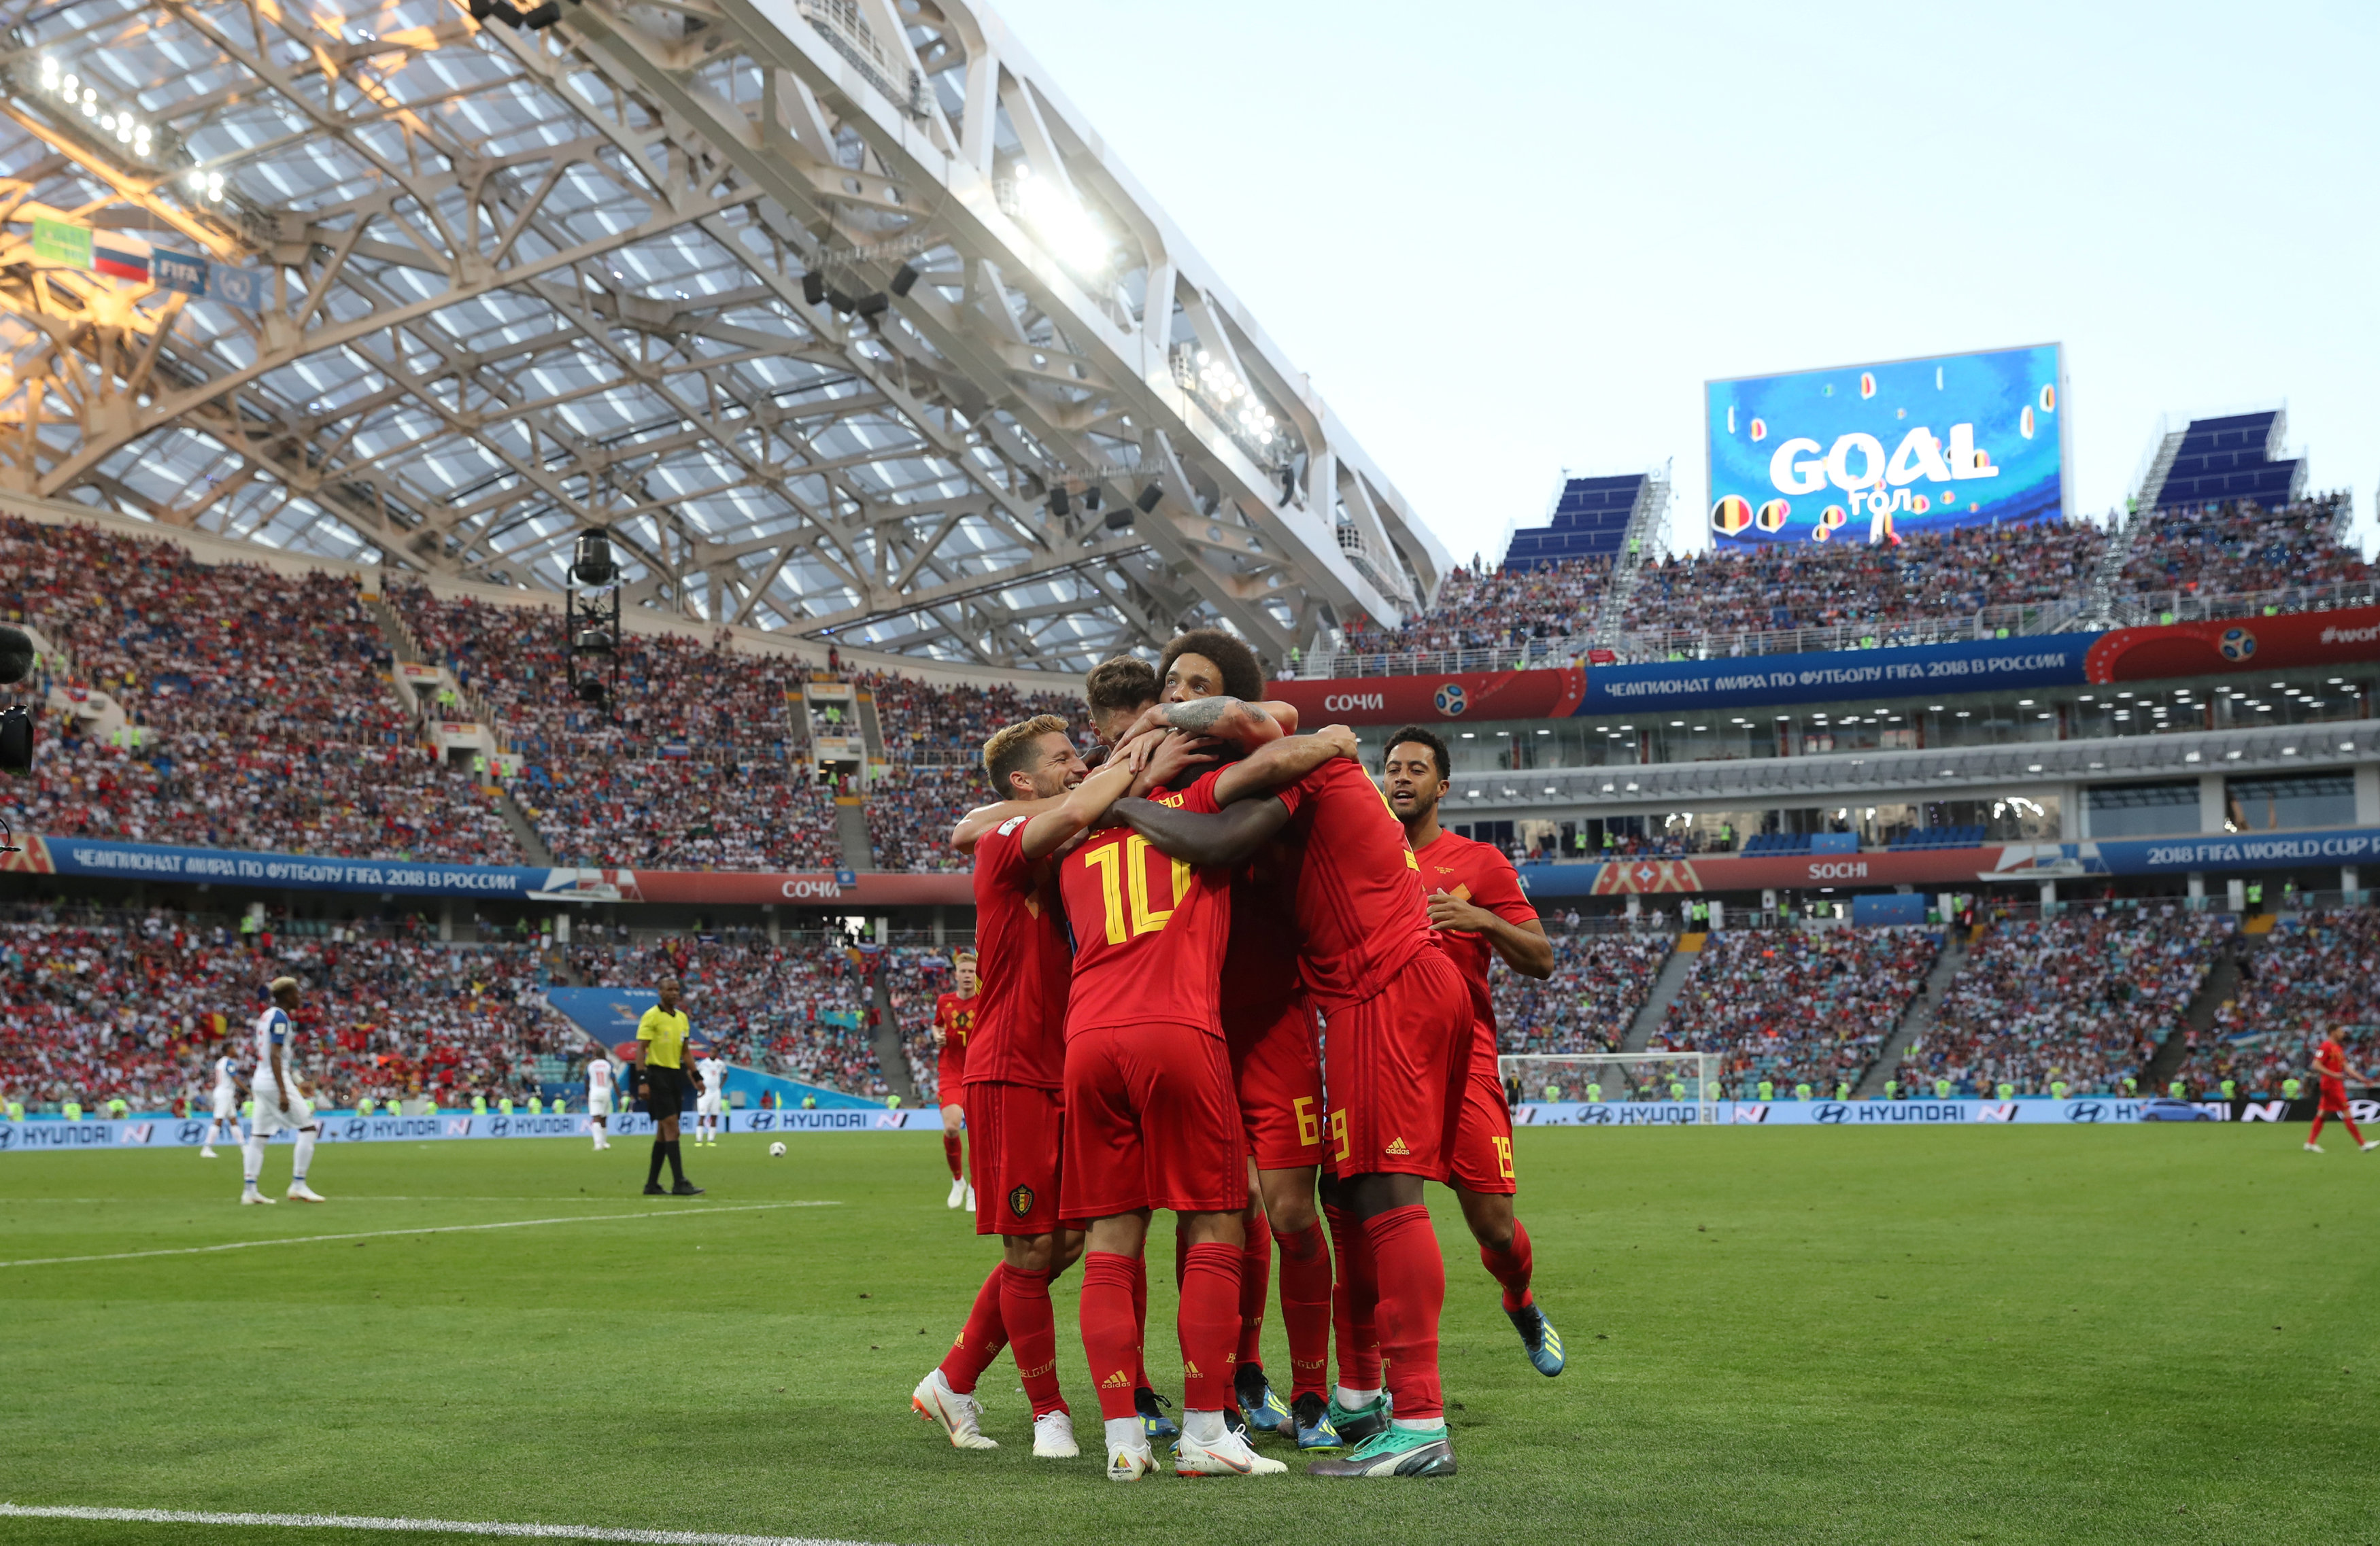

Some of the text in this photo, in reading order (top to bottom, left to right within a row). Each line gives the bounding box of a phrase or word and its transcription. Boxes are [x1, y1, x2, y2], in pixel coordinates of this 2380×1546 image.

[160, 259, 199, 283] FIFA
[1769, 423, 1999, 495] GOAL
[1851, 487, 1911, 515] ГОЛ
[2319, 622, 2380, 645] #wor
[1605, 677, 1710, 696] ЧЕМПИОНАТ
[1715, 673, 1767, 691] МИРА
[1770, 672, 1796, 687] ПО
[1799, 666, 1882, 685] ФУТБОЛУ
[1885, 663, 1924, 680] FIFA
[1927, 660, 1969, 677] 2018
[1988, 652, 2065, 672] РОССИИ
[1325, 693, 1383, 711] СОЧИ
[2148, 844, 2194, 865] 2018
[2197, 842, 2241, 862] FIFA
[2243, 838, 2320, 860] WORLD
[2322, 836, 2368, 857] CUP
[73, 848, 182, 872] ЧЕМПИОНАТ
[186, 857, 236, 876] МИРА
[239, 859, 264, 878] ПО
[266, 862, 343, 883] ФУТБОЛУ
[345, 866, 382, 884] FIFA
[386, 868, 426, 886] 2018
[443, 871, 516, 890] РОССИИ
[1808, 862, 1868, 880] SOCHI
[782, 881, 841, 898] СОЧИ
[1085, 834, 1191, 945] 10
[957, 1031, 967, 1046] 7
[784, 1114, 866, 1128] HYUNDAI
[1293, 1096, 1320, 1146] 6
[1620, 1107, 1718, 1122] HYUNDAI
[1860, 1105, 1964, 1120] HYUNDAI
[22, 1124, 112, 1144] HYUNDAI
[374, 1120, 441, 1136] HYUNDAI
[515, 1118, 570, 1133] HYUNDAI
[1330, 1108, 1350, 1162] 9
[1386, 1148, 1410, 1156] adidas
[1492, 1136, 1516, 1178] 19
